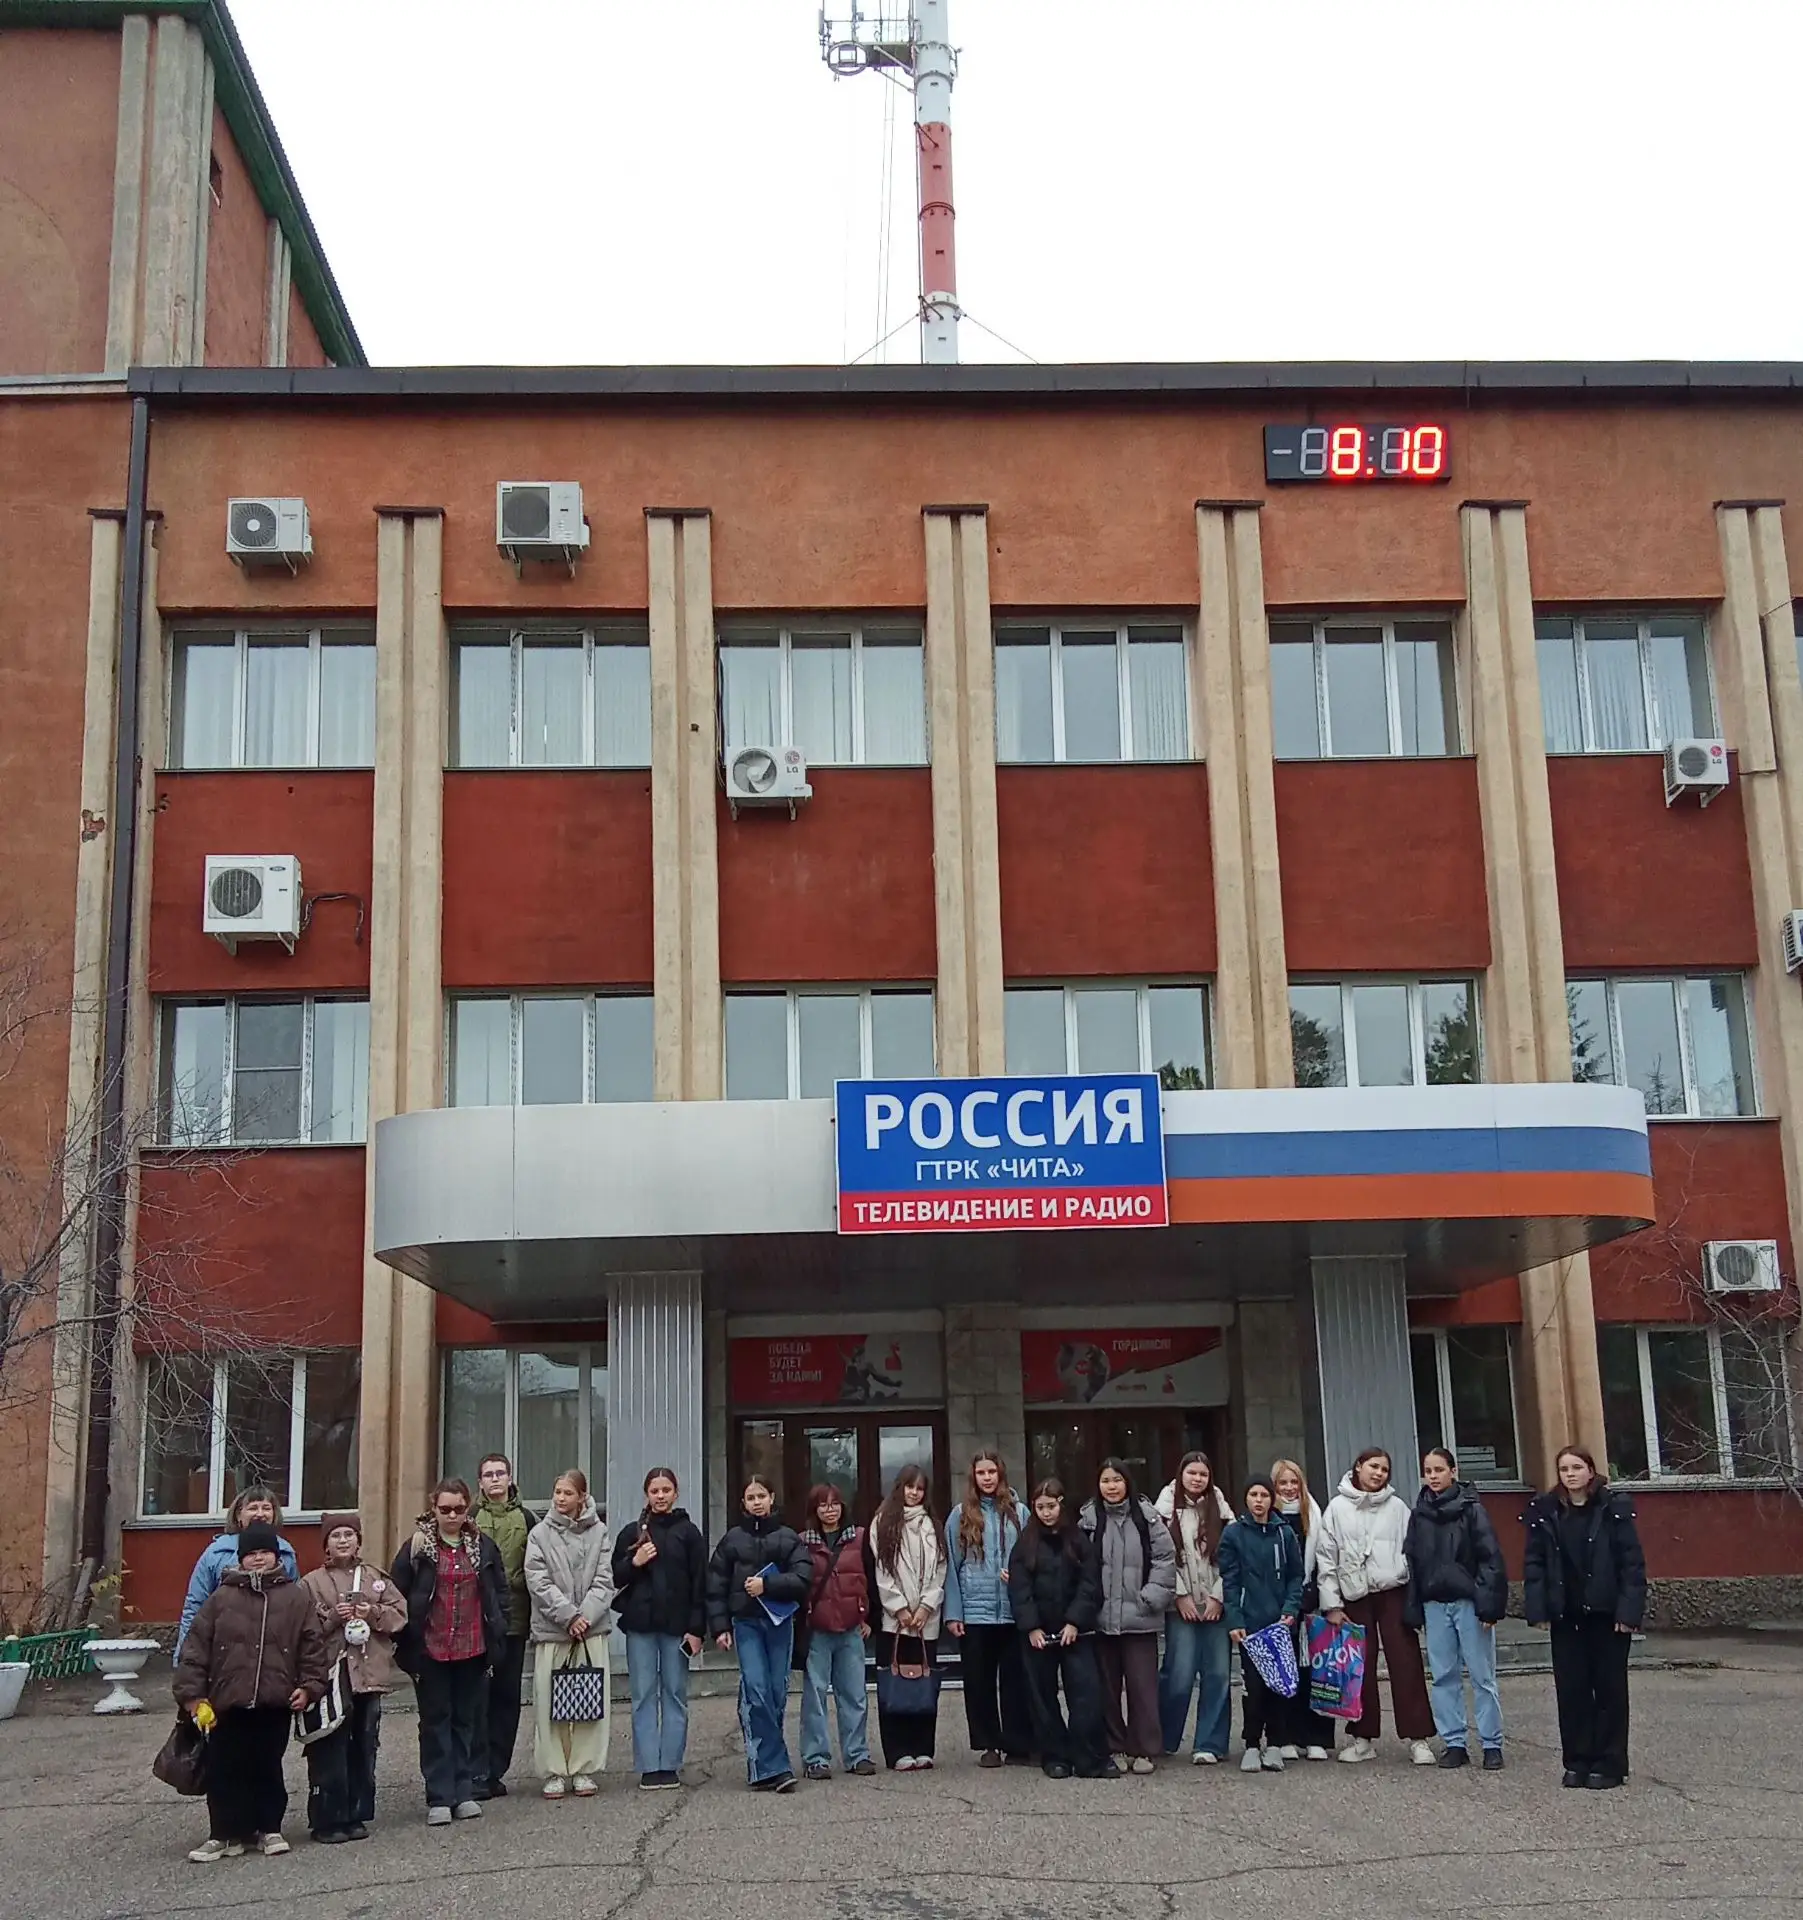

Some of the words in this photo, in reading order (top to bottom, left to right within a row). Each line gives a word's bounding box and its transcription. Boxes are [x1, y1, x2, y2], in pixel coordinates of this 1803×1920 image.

[864, 1088, 1144, 1149] РОССИЯ
[916, 1159, 980, 1181] ГТРК
[987, 1157, 1085, 1179] «ЧИТА»
[853, 1199, 1035, 1225] ТЕЛЕВИДЕНИЕ
[1041, 1198, 1058, 1218] И
[1065, 1196, 1152, 1220] РАДИО
[768, 1341, 812, 1355] ПОБЕДА
[768, 1356, 802, 1370] БУДЕТ
[768, 1370, 784, 1383] ЗА
[1311, 1644, 1363, 1669] OZON
